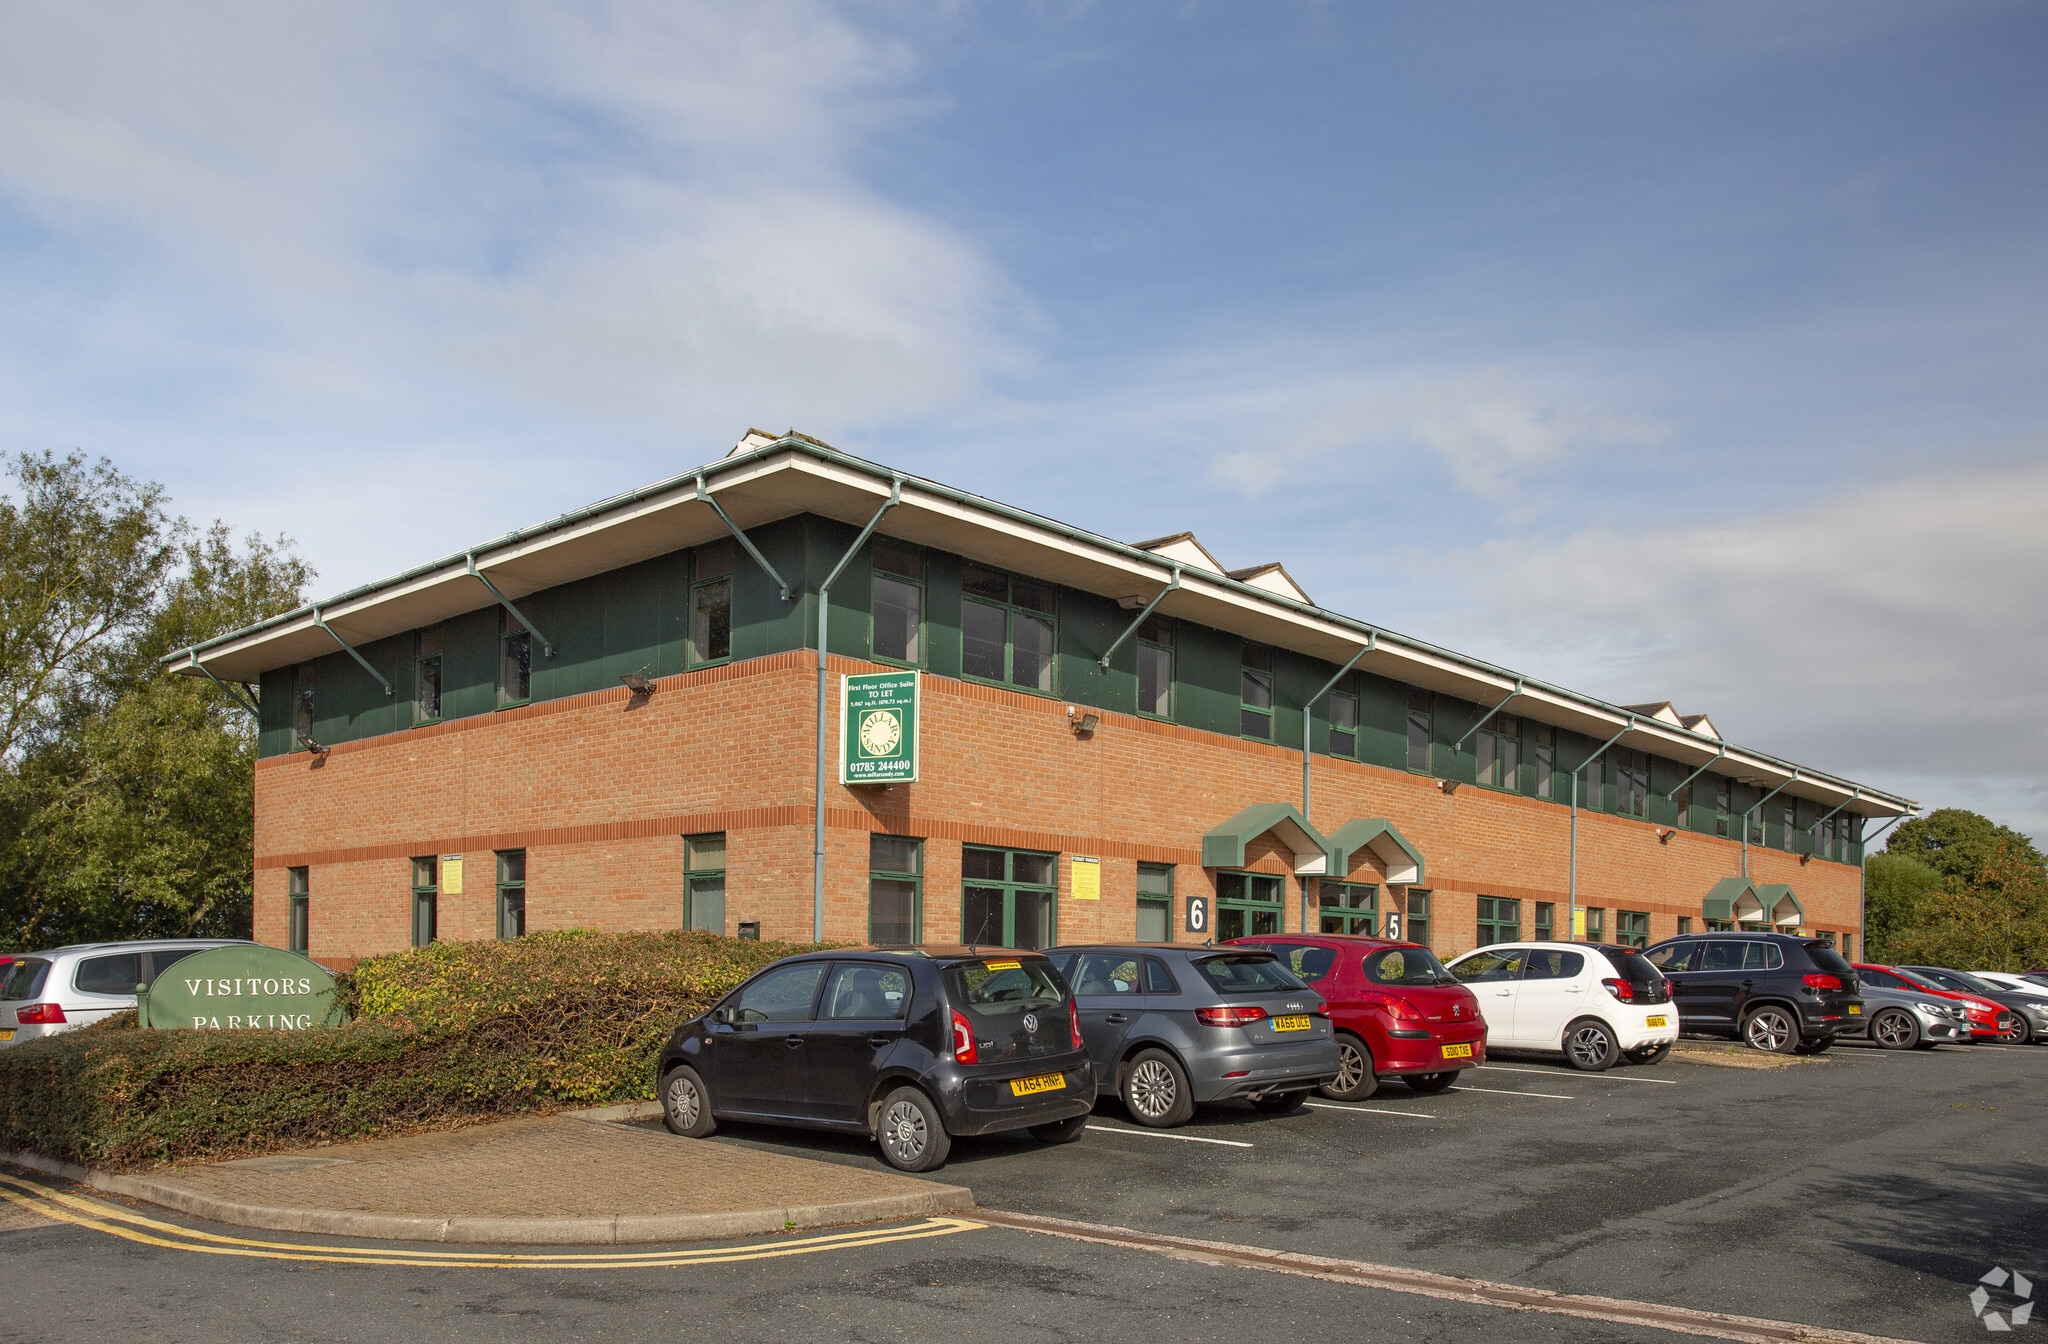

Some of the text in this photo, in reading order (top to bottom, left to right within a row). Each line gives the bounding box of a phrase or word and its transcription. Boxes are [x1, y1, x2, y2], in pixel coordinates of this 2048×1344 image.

[863, 713, 898, 735] MILLAR
[865, 737, 896, 754] SANDY
[850, 760, 911, 772] 01785 244400
[1190, 899, 1204, 930] 6
[1389, 914, 1399, 940] 5
[185, 978, 311, 997] VISITORS
[192, 1014, 312, 1031] PARKING
[1015, 1077, 1042, 1093] VA64
